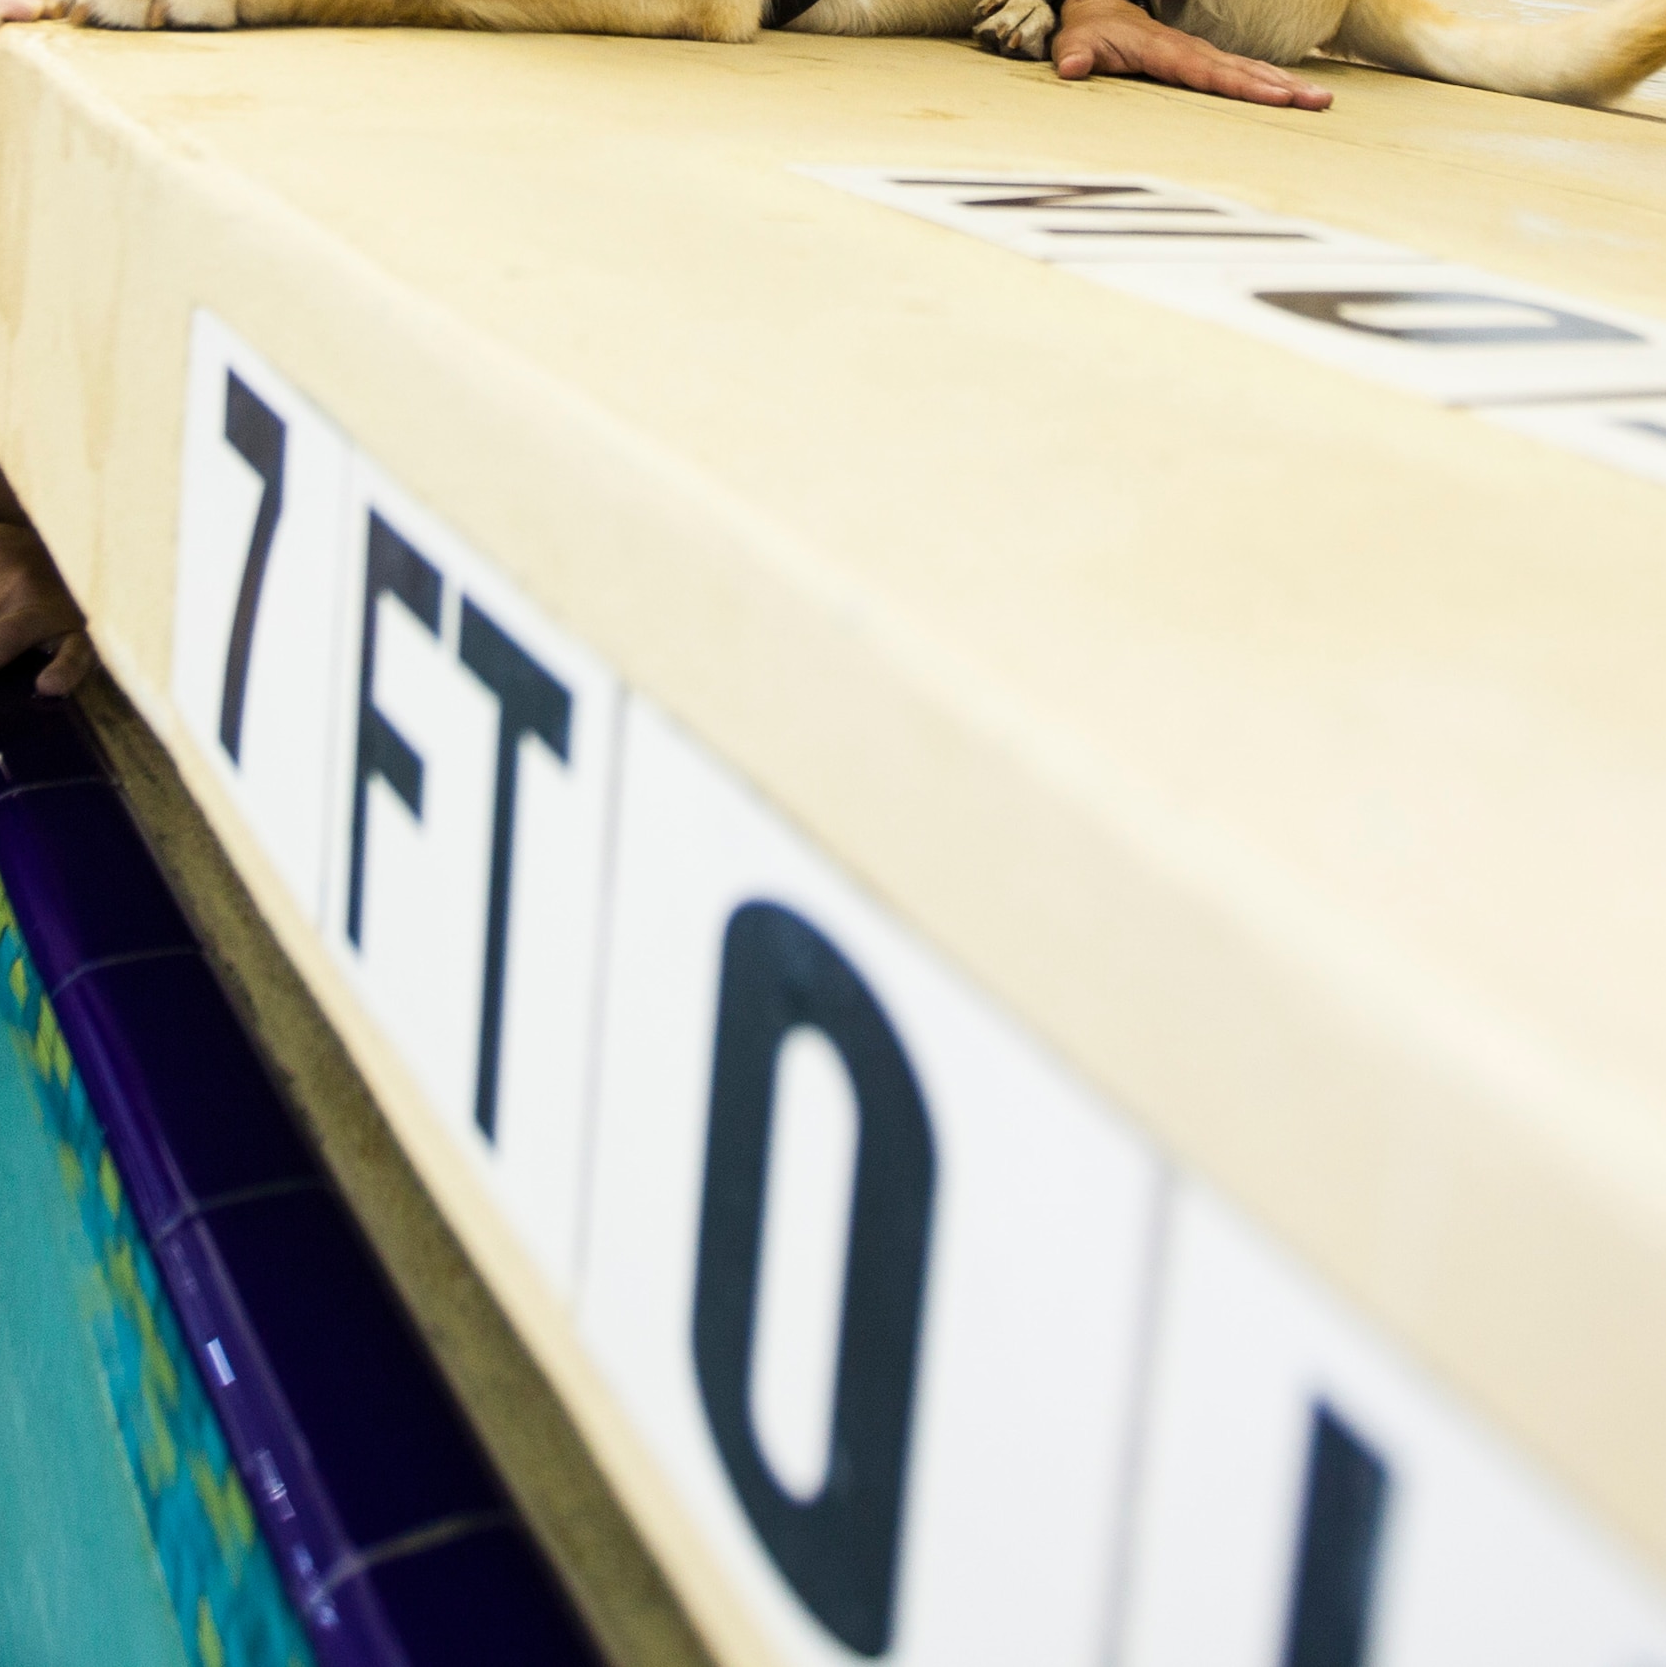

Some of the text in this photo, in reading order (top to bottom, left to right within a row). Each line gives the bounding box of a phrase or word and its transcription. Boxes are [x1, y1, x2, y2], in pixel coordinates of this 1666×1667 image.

[890, 180, 1321, 241] IN
[222, 365, 287, 774] 7
[346, 504, 574, 1152] FT
